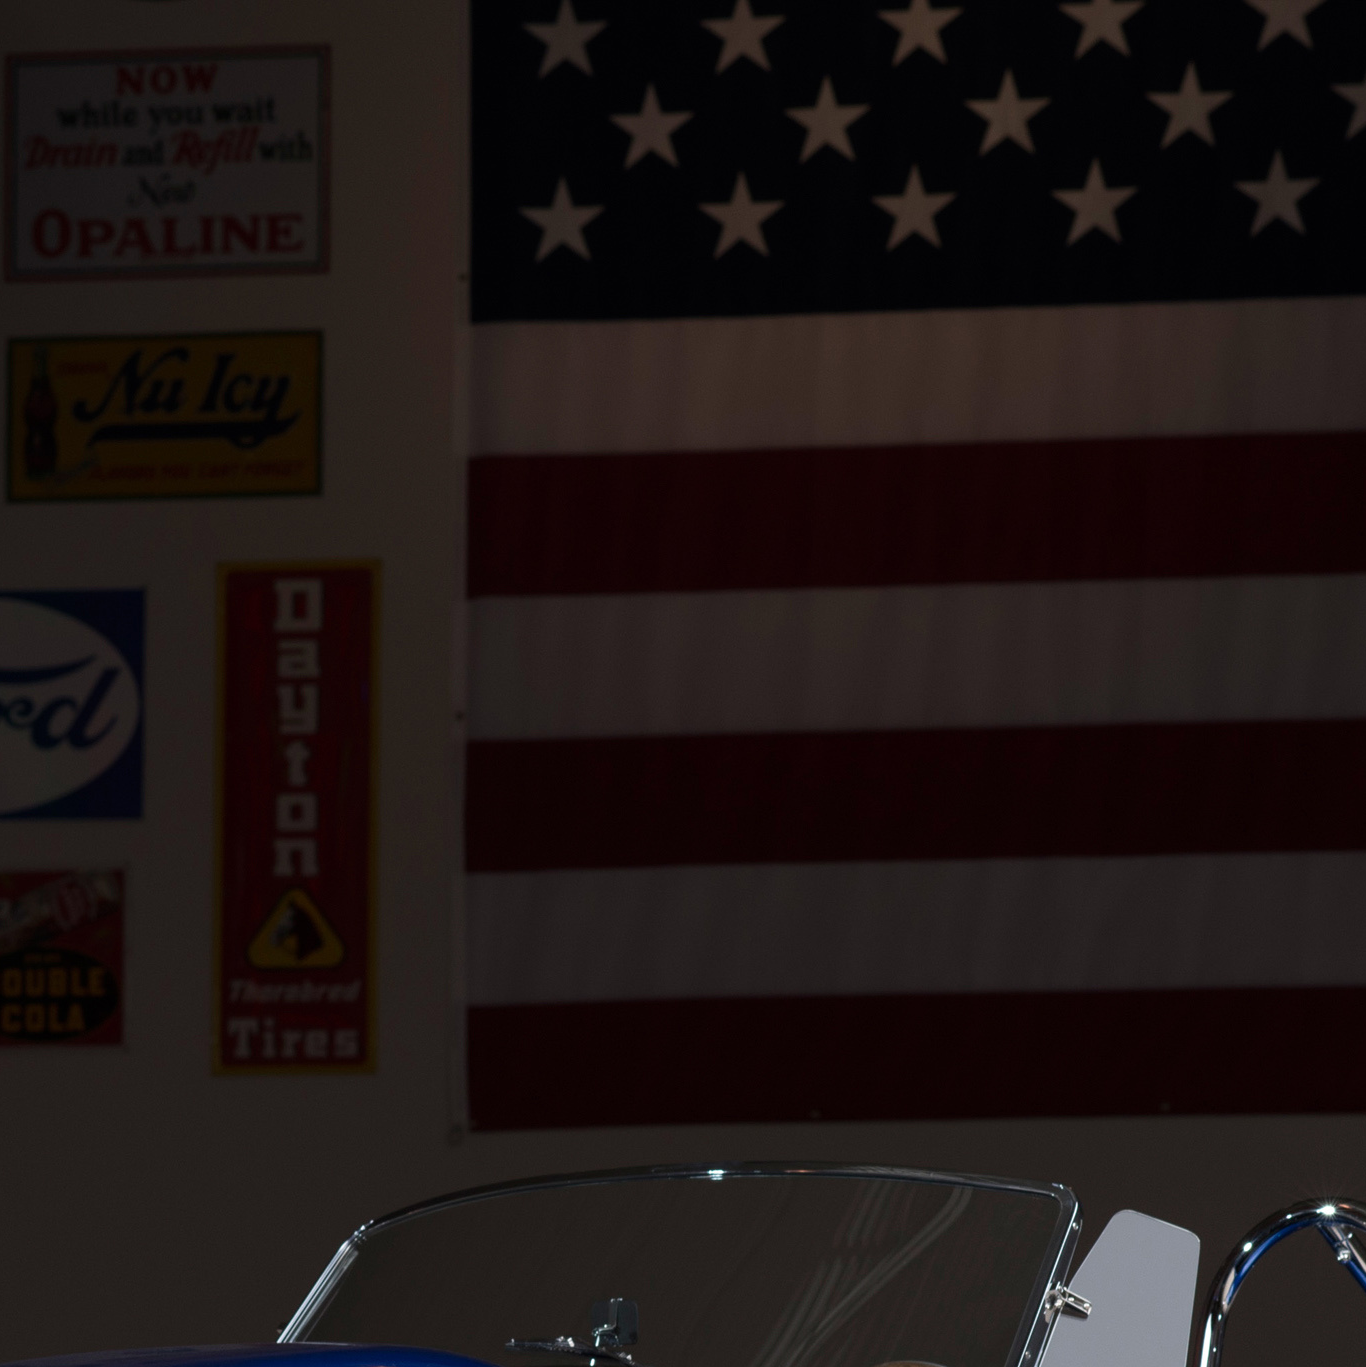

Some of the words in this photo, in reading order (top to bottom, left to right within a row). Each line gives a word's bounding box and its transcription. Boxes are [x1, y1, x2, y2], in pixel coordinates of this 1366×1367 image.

[116, 63, 218, 96] NOW
[56, 98, 138, 129] while
[148, 104, 204, 135] you
[211, 97, 277, 124] wait
[24, 134, 119, 170] Drain
[122, 139, 165, 166] and
[170, 126, 261, 176] Refill
[259, 130, 314, 162] with
[73, 346, 191, 423] Nu
[199, 353, 295, 428] Icy
[272, 577, 324, 878] Dayton
[0, 1003, 87, 1034] COLA
[227, 1016, 360, 1060] Tires
